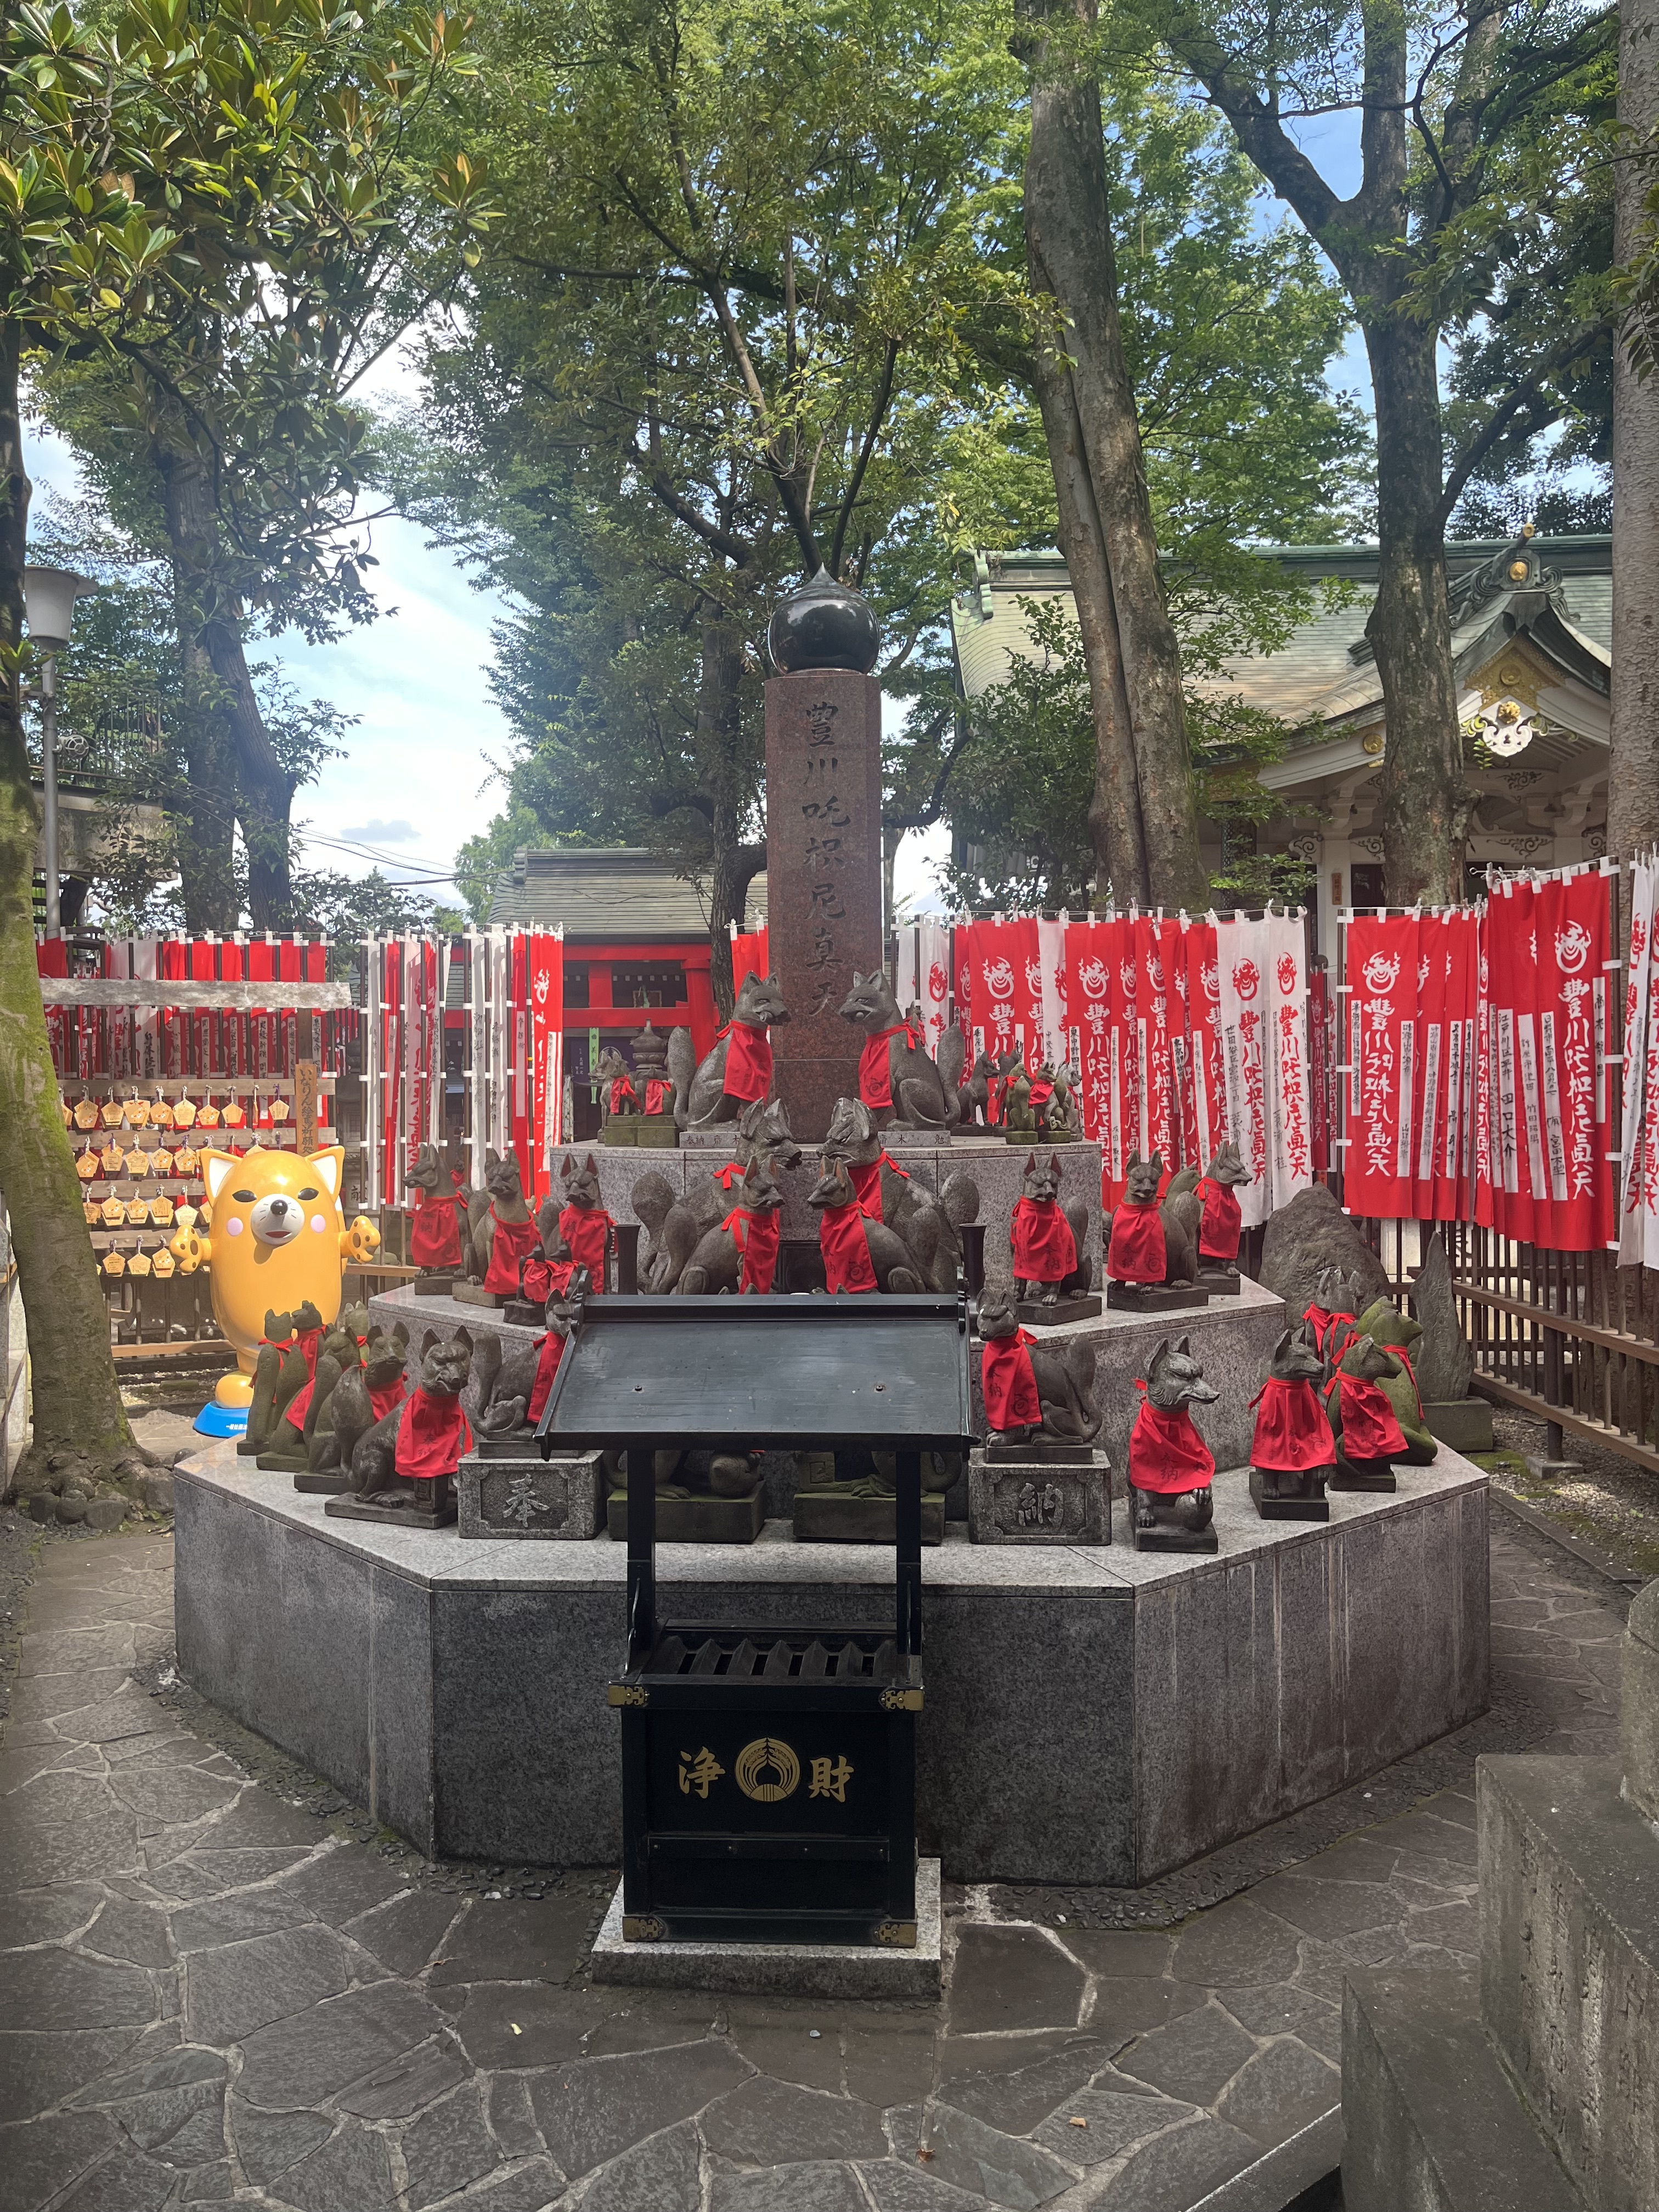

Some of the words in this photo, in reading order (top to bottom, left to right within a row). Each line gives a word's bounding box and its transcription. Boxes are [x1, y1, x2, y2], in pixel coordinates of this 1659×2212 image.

[503, 1473, 549, 1528] 奉
[1018, 1482, 1064, 1530] 納
[678, 1746, 726, 1799] 浄
[808, 1754, 855, 1803] 財
